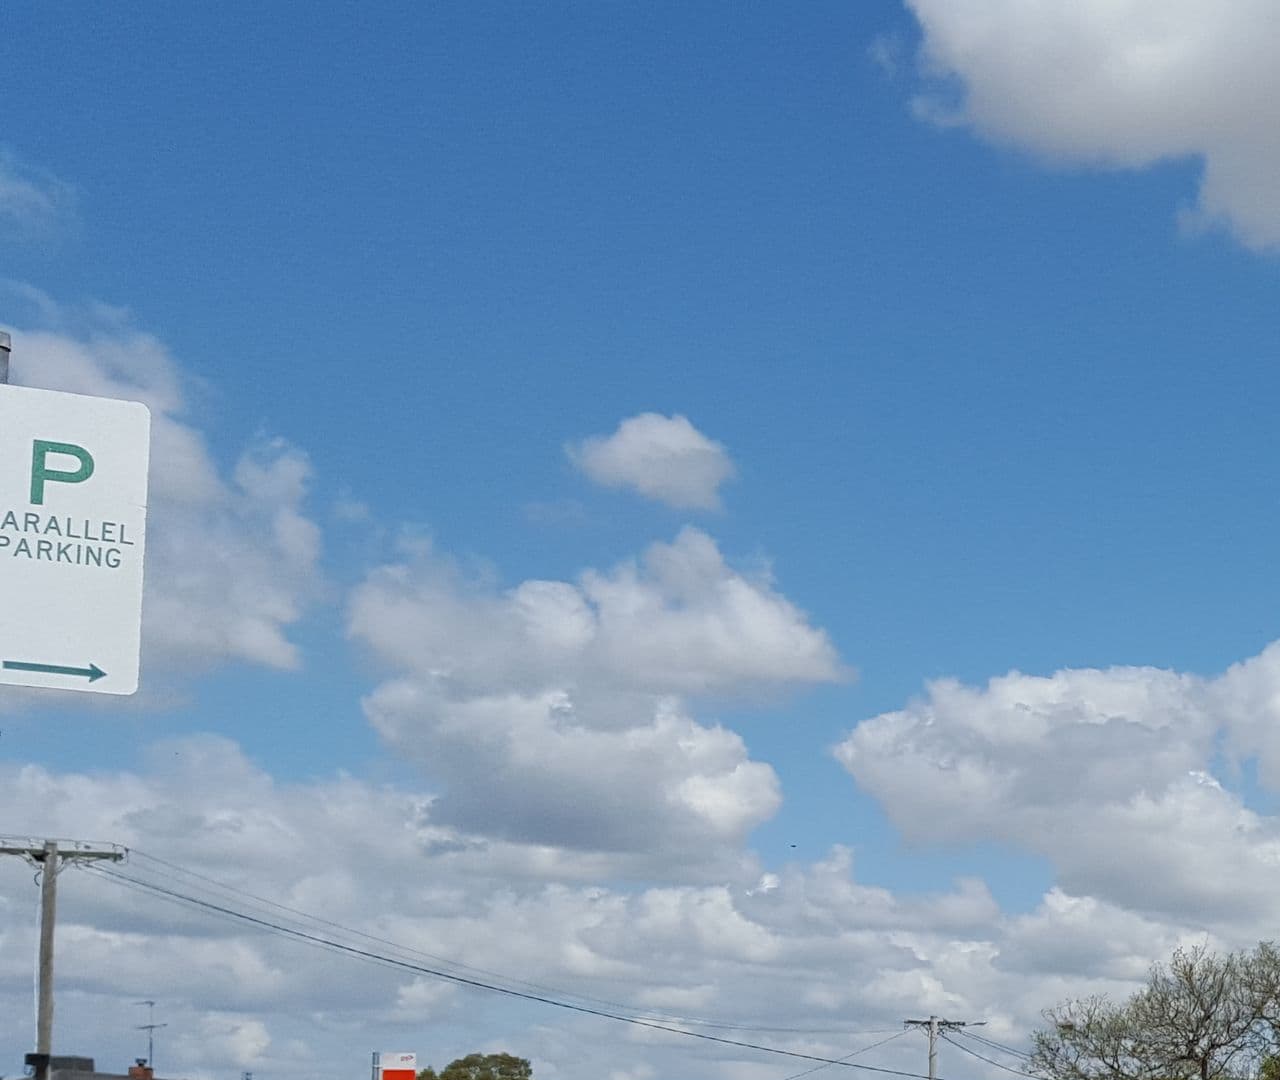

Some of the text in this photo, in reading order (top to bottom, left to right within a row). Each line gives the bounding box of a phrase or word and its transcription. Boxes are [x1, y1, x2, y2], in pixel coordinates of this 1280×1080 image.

[30, 439, 94, 505] P
[0, 510, 134, 545] ARALLEL
[0, 535, 121, 568] PARKING
